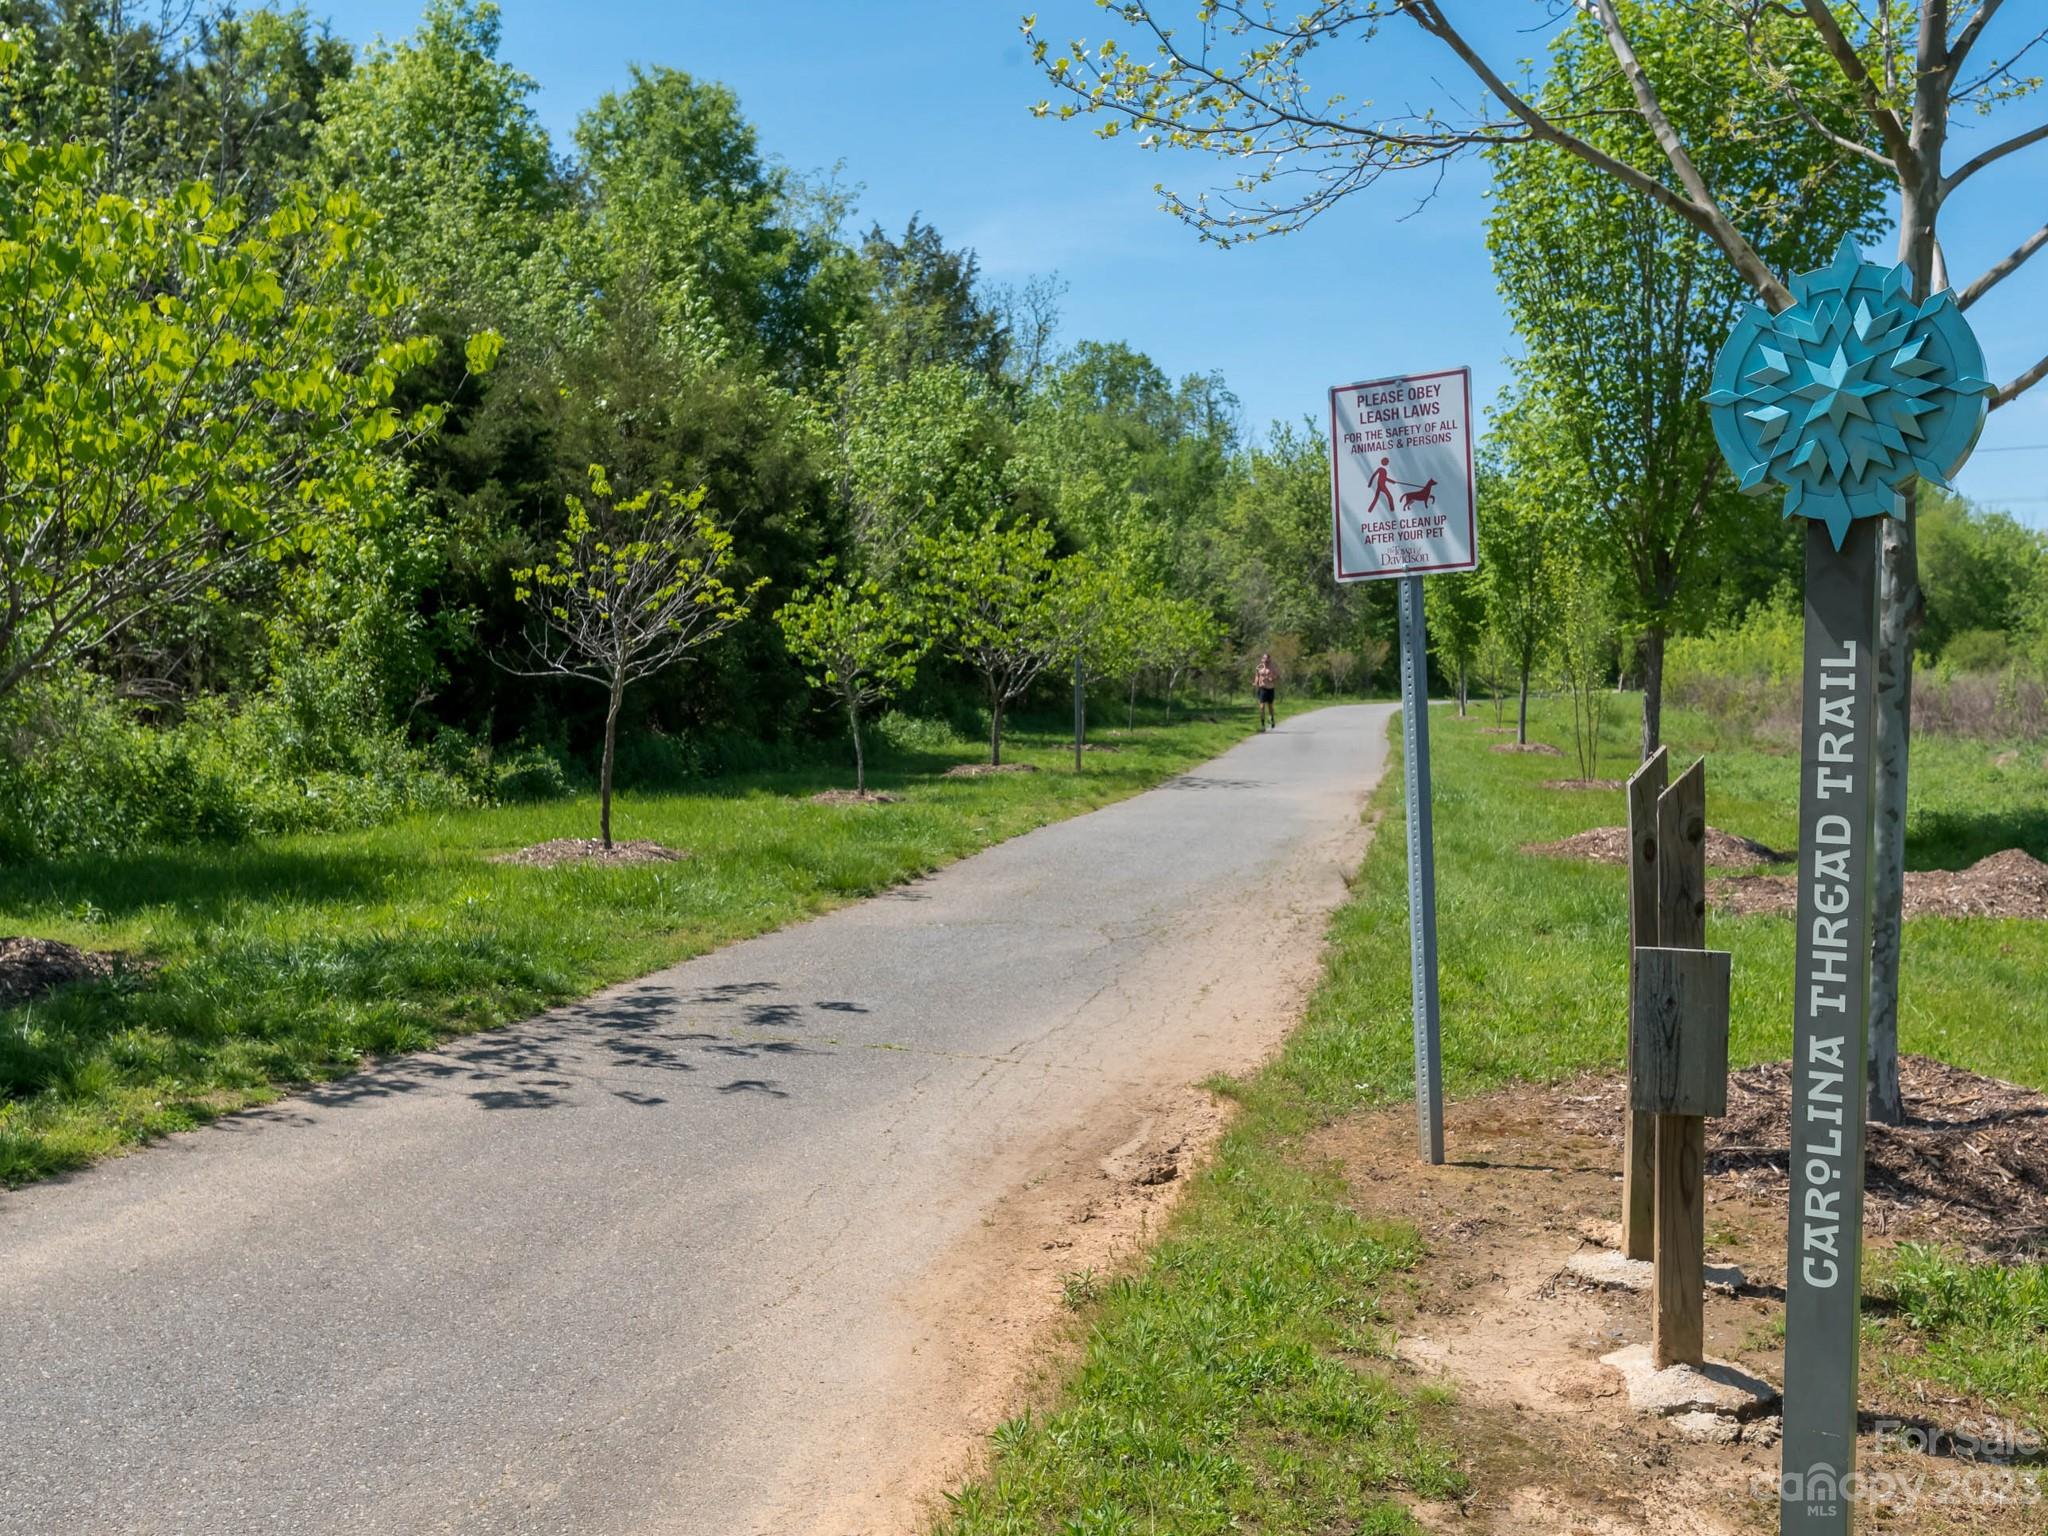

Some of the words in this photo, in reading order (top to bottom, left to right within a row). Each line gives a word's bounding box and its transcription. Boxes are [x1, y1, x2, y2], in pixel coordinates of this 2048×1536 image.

[1357, 389, 1404, 408] PLEASE
[1408, 384, 1441, 401] OBEY
[1360, 407, 1399, 424] LEASH
[1404, 402, 1440, 418] LAWS
[1344, 432, 1362, 444] FOR
[1365, 429, 1383, 441] THE
[1386, 424, 1421, 438] SAFETY
[1424, 422, 1437, 433] OF
[1440, 419, 1458, 431] ALL
[1351, 439, 1393, 454] ANIMALS
[1396, 438, 1404, 449] &
[1406, 432, 1452, 448] PERSONS
[1361, 520, 1397, 533] PLEASE
[1399, 516, 1431, 530] CLEAN
[1434, 514, 1447, 526] UP
[1364, 532, 1394, 545] AFTER
[1398, 529, 1423, 541] YOUR
[1426, 527, 1445, 539] PET
[1381, 552, 1429, 566] Davidson
[1816, 640, 1857, 799] TRAIL
[1810, 814, 1852, 1017] THREAD
[1803, 1034, 1845, 1288] CAROLINA
